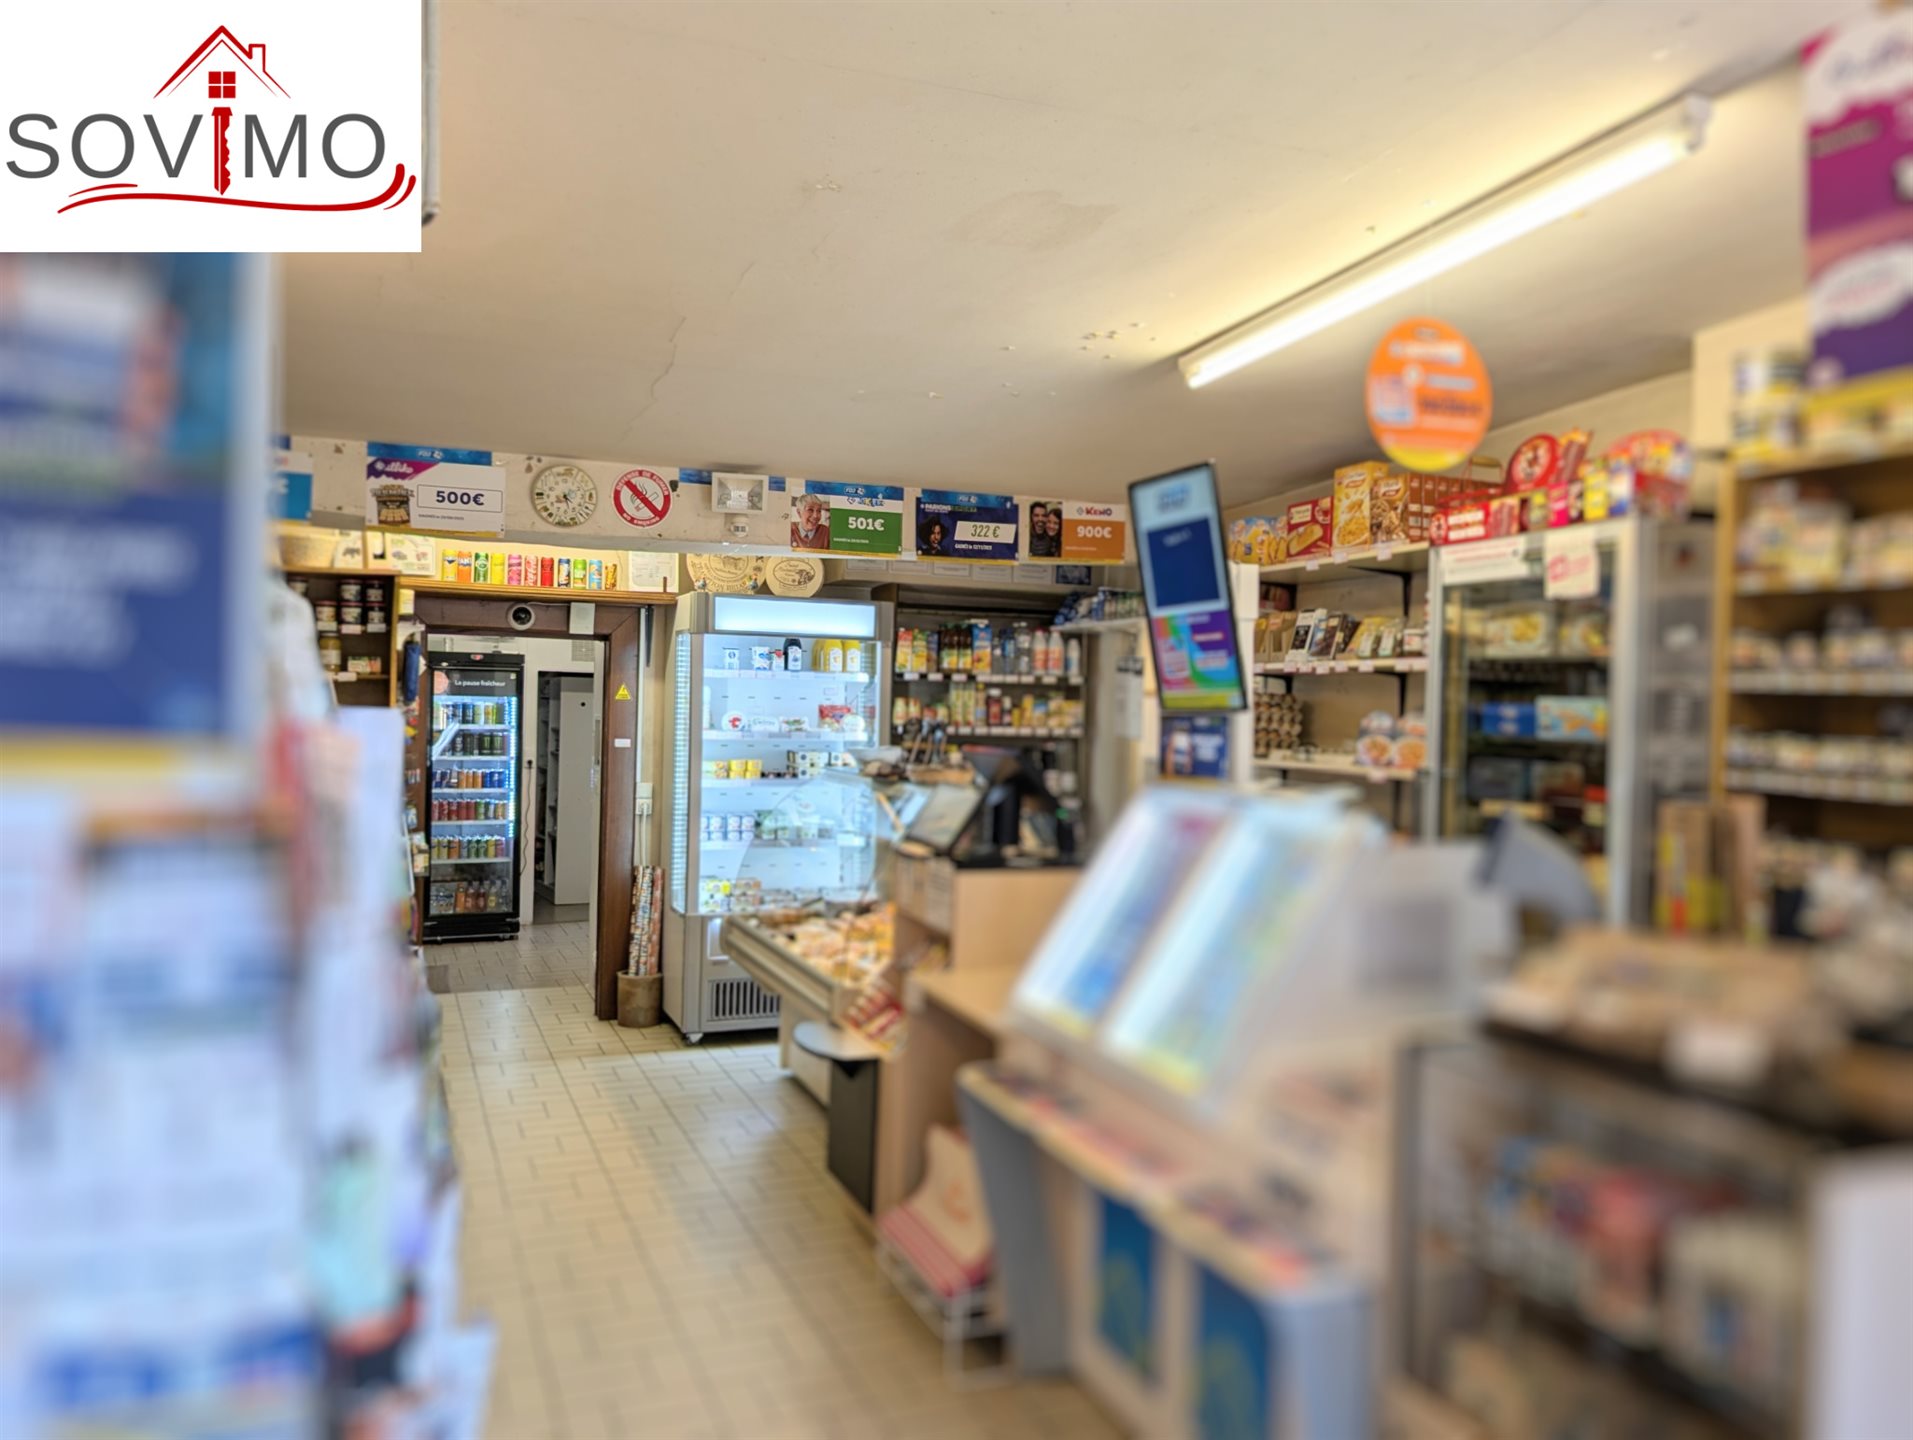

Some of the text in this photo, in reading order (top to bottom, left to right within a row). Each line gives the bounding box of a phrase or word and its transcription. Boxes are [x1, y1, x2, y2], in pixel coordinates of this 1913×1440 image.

[435, 490, 485, 506] 500€
[848, 516, 885, 531] 501€
[971, 524, 1000, 538] 322 €
[1077, 526, 1112, 538] 900€
